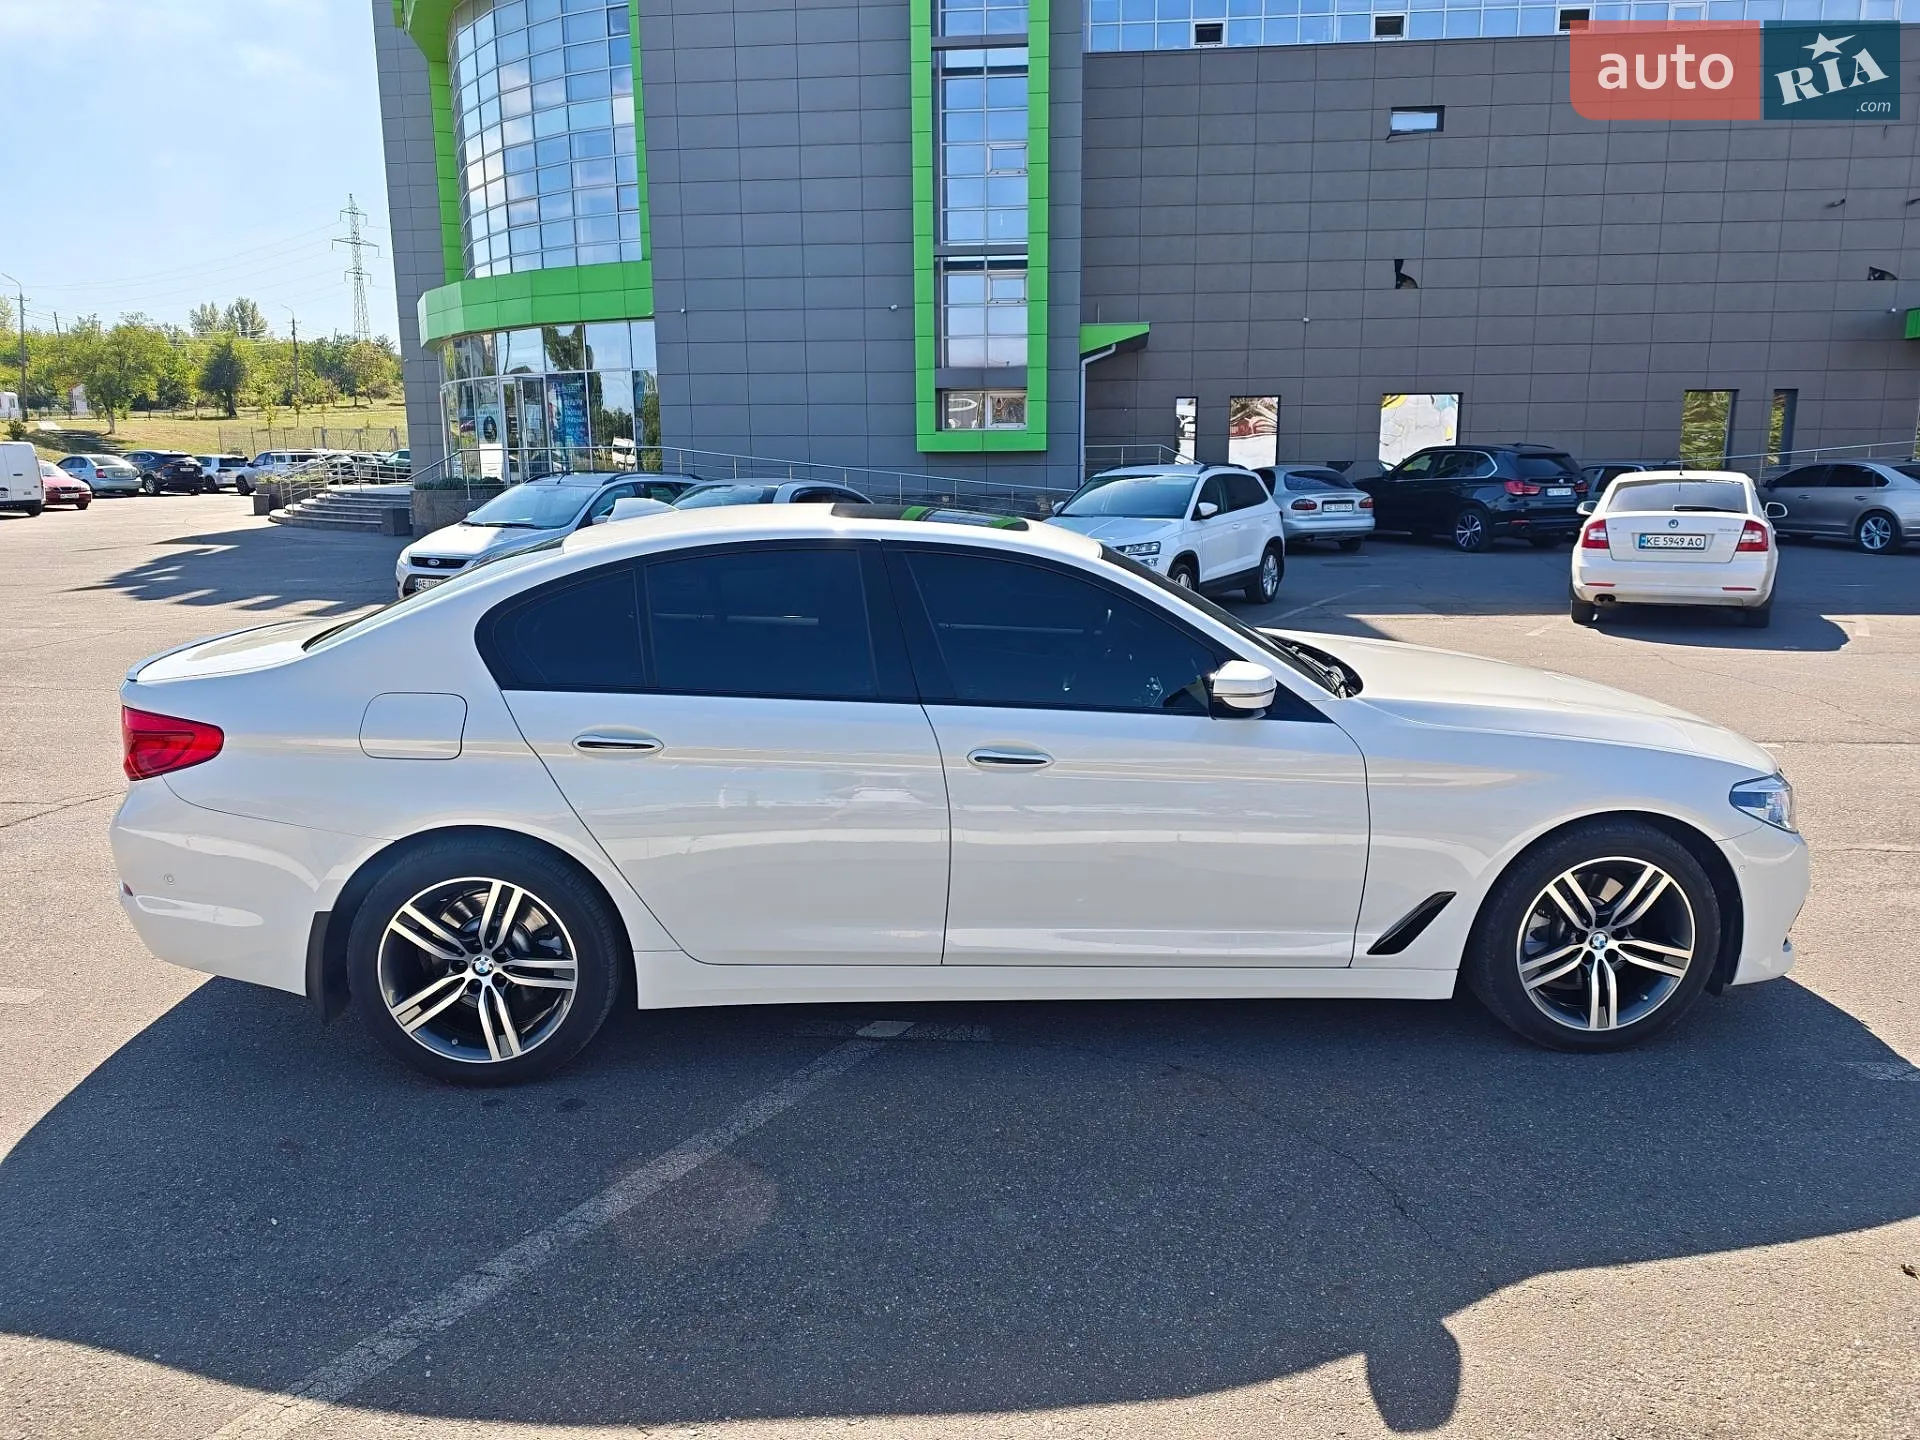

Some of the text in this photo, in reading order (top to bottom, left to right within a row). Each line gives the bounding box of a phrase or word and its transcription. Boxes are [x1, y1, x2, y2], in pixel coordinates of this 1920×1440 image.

[1646, 536, 1703, 547] KE 5949 AO
